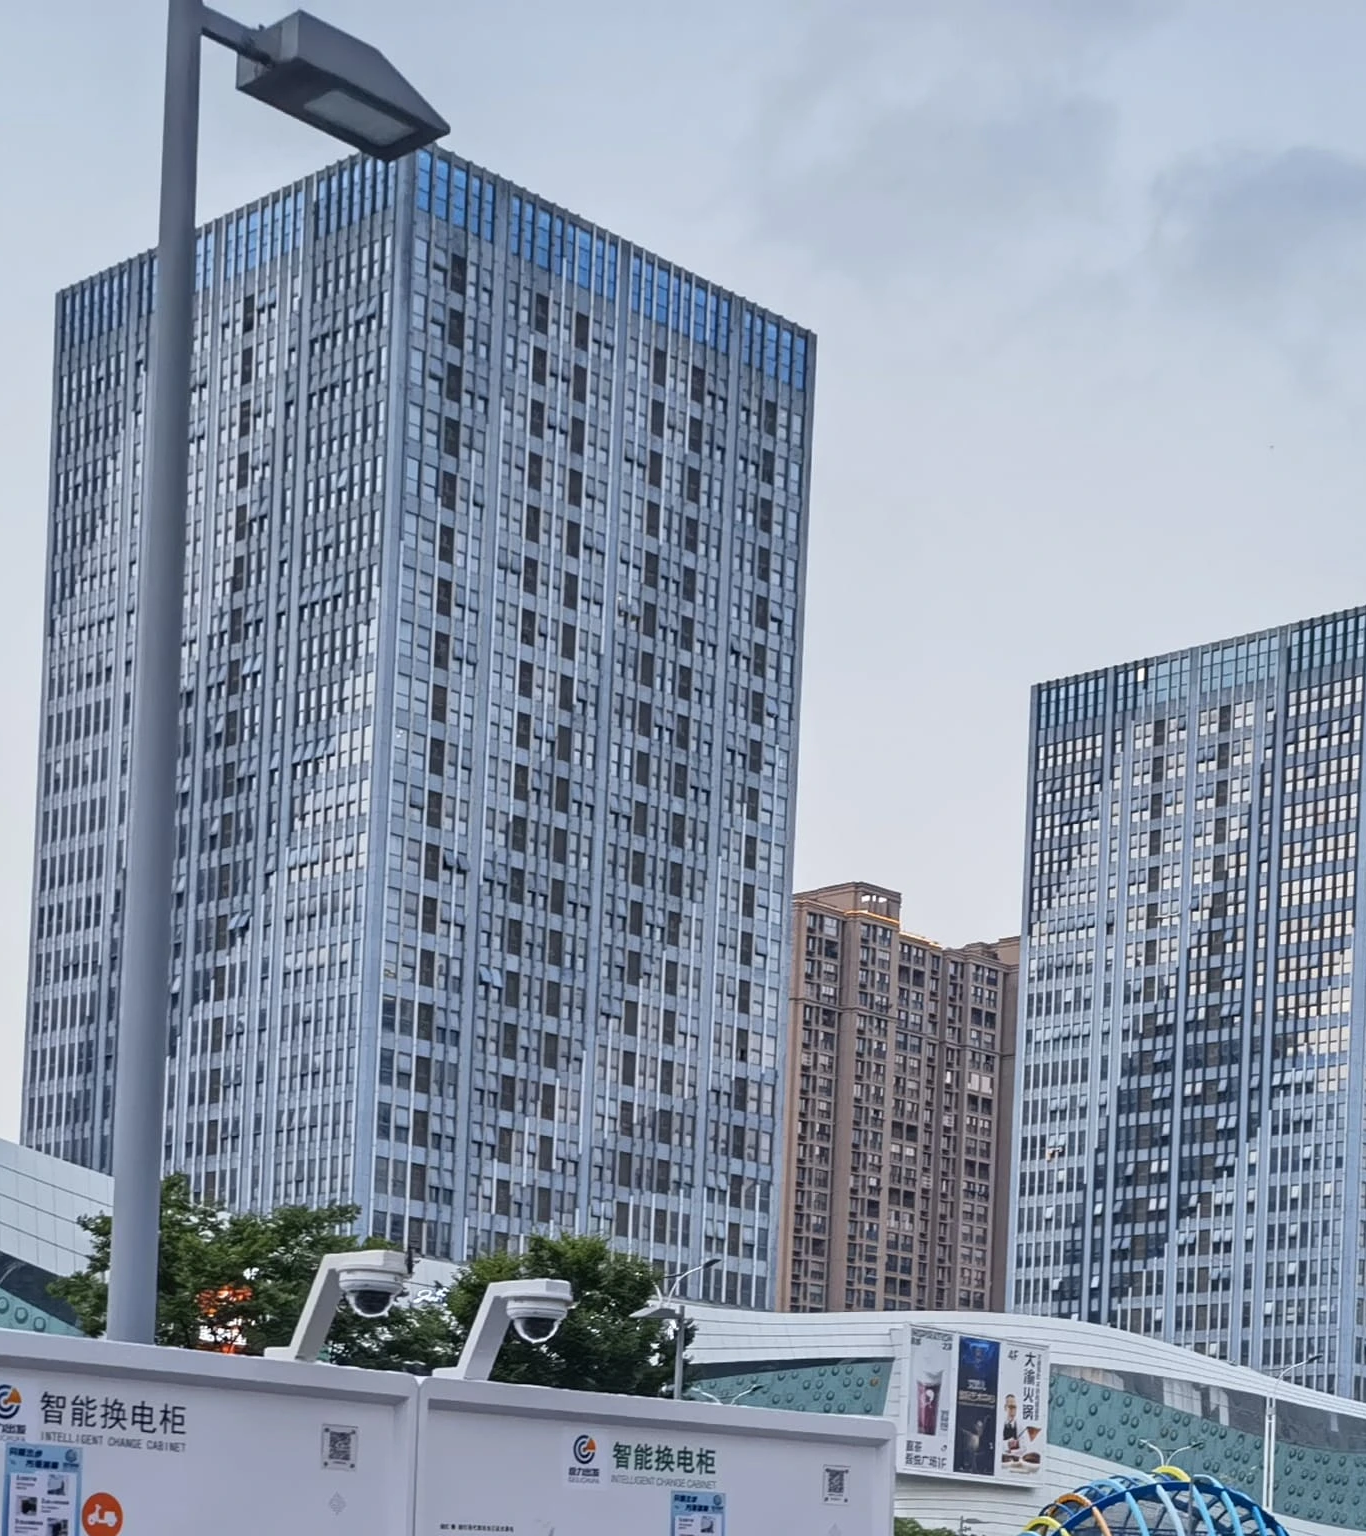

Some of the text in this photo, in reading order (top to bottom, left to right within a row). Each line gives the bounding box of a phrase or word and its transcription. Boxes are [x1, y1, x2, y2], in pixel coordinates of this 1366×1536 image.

[40, 1391, 187, 1435] 智能换电柜
[41, 1431, 187, 1453] INTELLIGENT CHANGE CABINET
[612, 1441, 716, 1475] 智能换电柜
[611, 1474, 655, 1486] INTELLIGENT
[686, 1479, 717, 1490] CABINET
